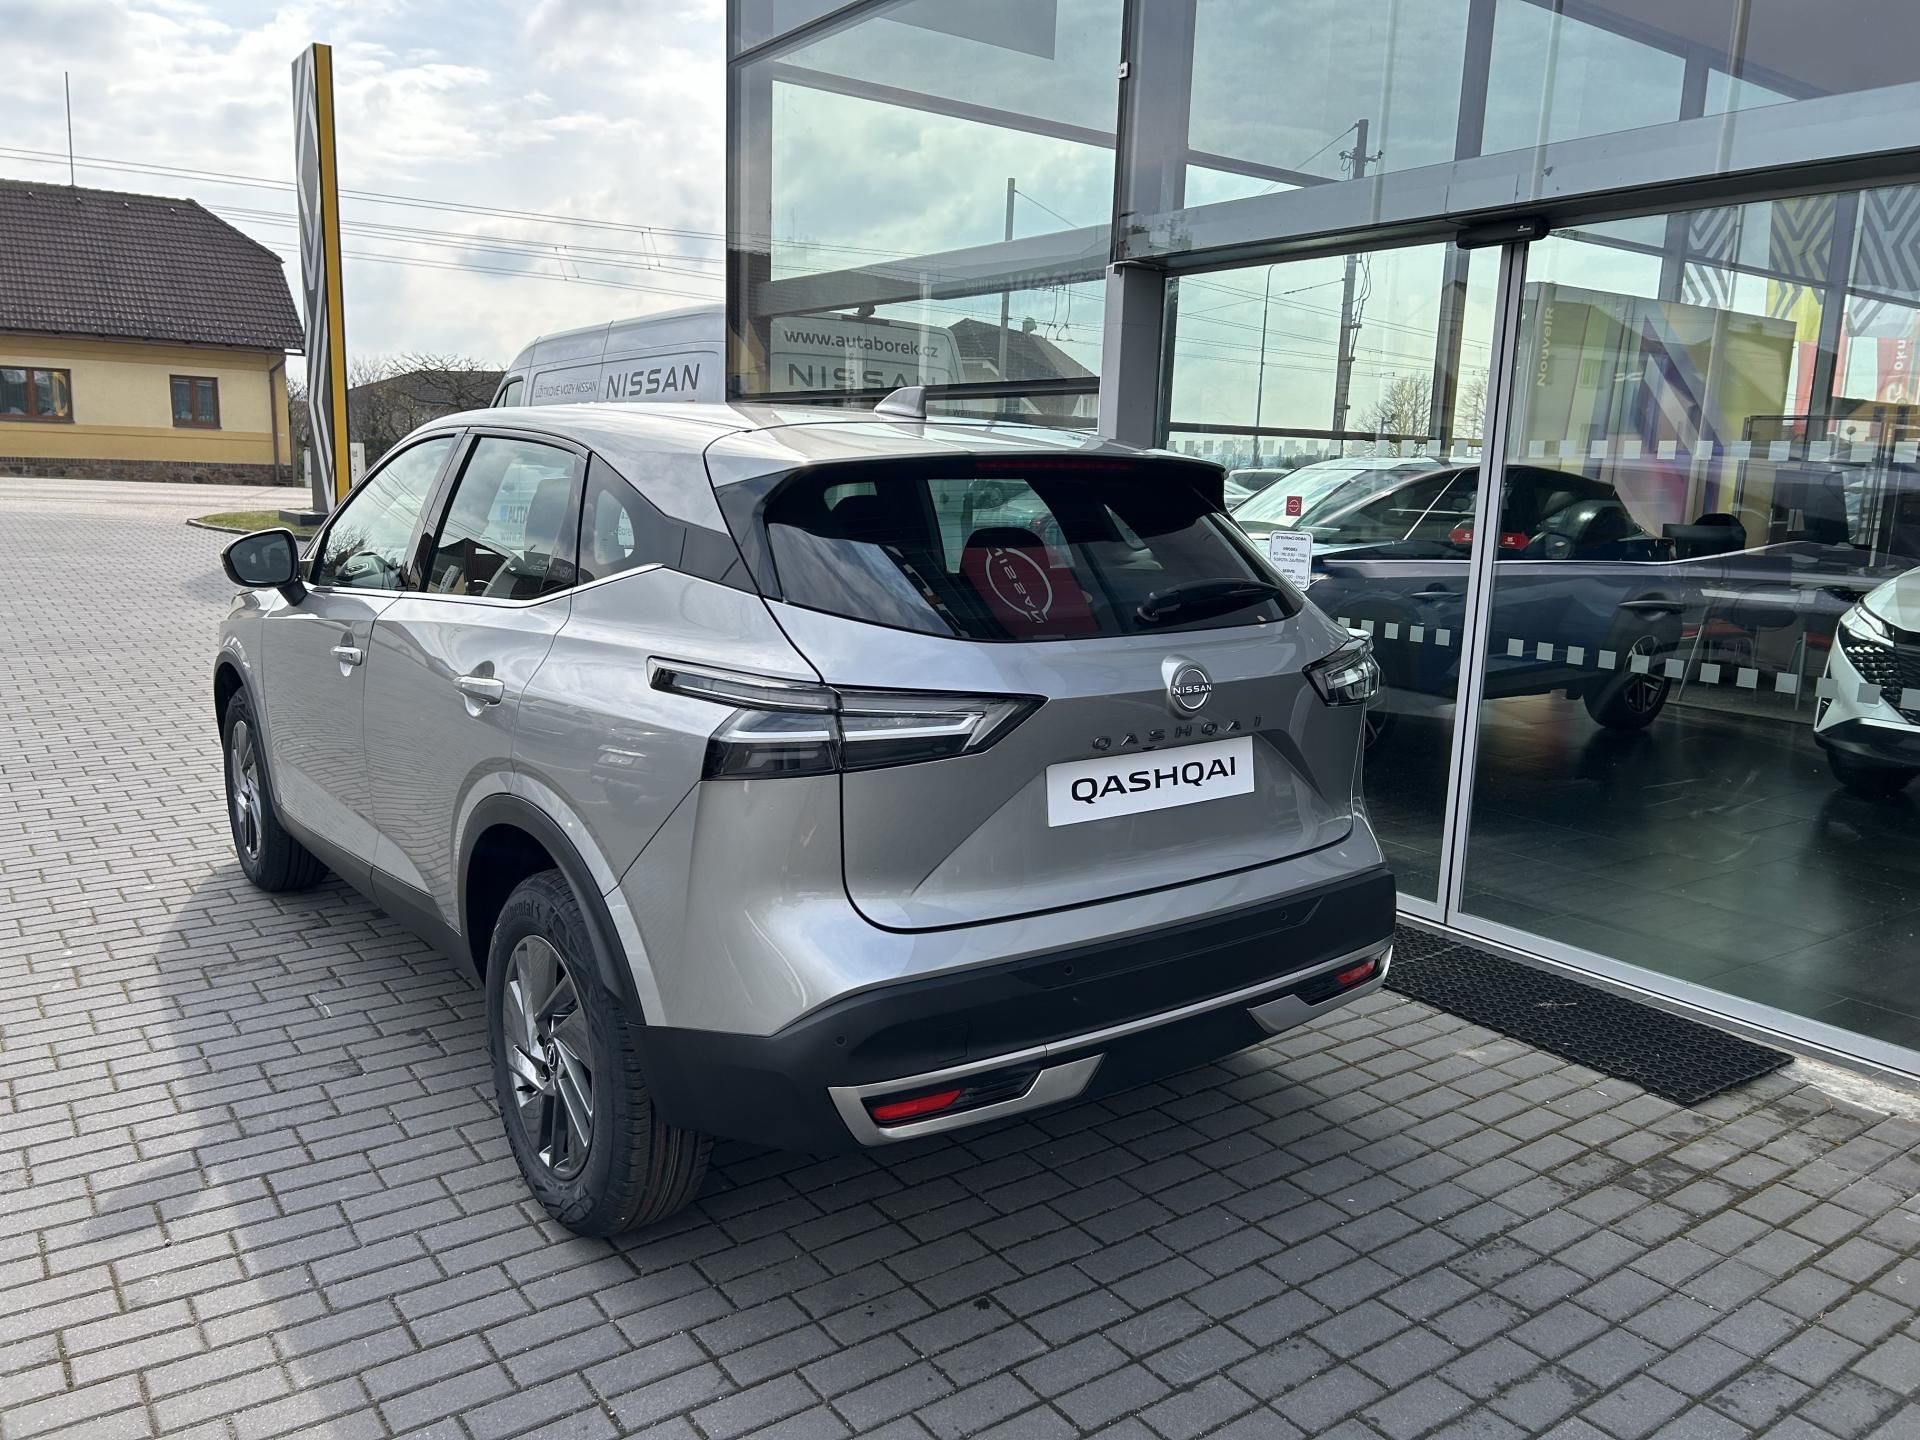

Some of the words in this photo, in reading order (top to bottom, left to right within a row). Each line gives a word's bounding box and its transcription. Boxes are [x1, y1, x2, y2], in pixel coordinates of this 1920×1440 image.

[784, 330, 938, 358] www.autaborek.cz
[576, 380, 598, 393] NISSAN
[605, 363, 701, 399] NISSAN
[1173, 683, 1212, 695] NISSAN
[1092, 715, 1262, 751] QASHQAI
[1071, 756, 1237, 804] QASHQAI
